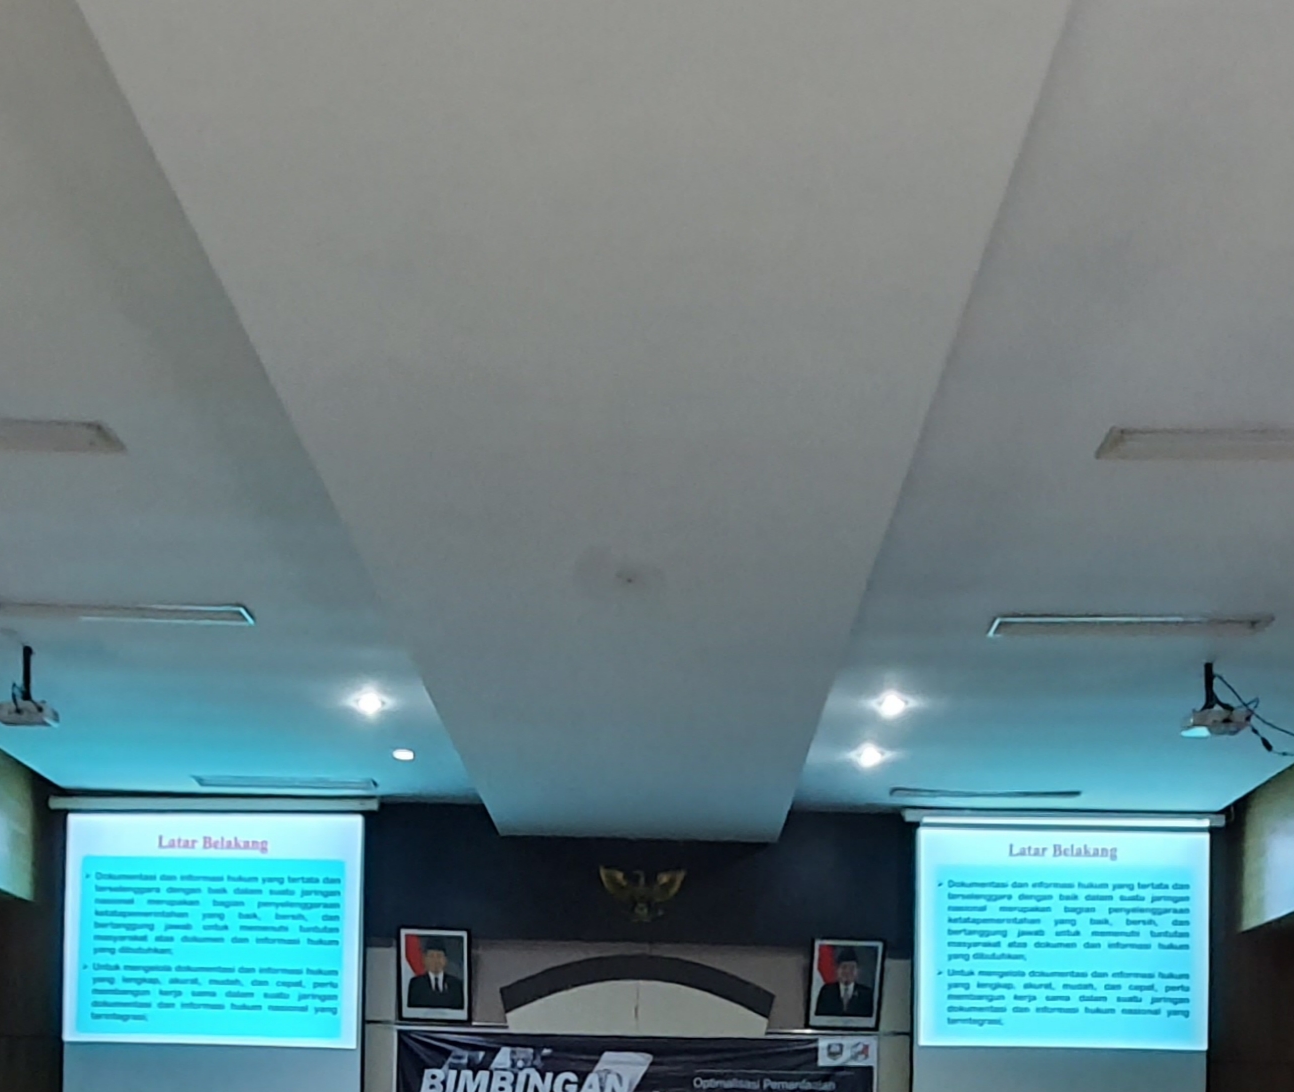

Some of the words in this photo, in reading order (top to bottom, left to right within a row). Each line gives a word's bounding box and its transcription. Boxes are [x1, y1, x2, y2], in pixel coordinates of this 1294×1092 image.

[158, 834, 198, 849] Latar
[203, 836, 268, 854] Belakang
[1009, 843, 1047, 857] Latar
[1053, 844, 1117, 861] Belakang
